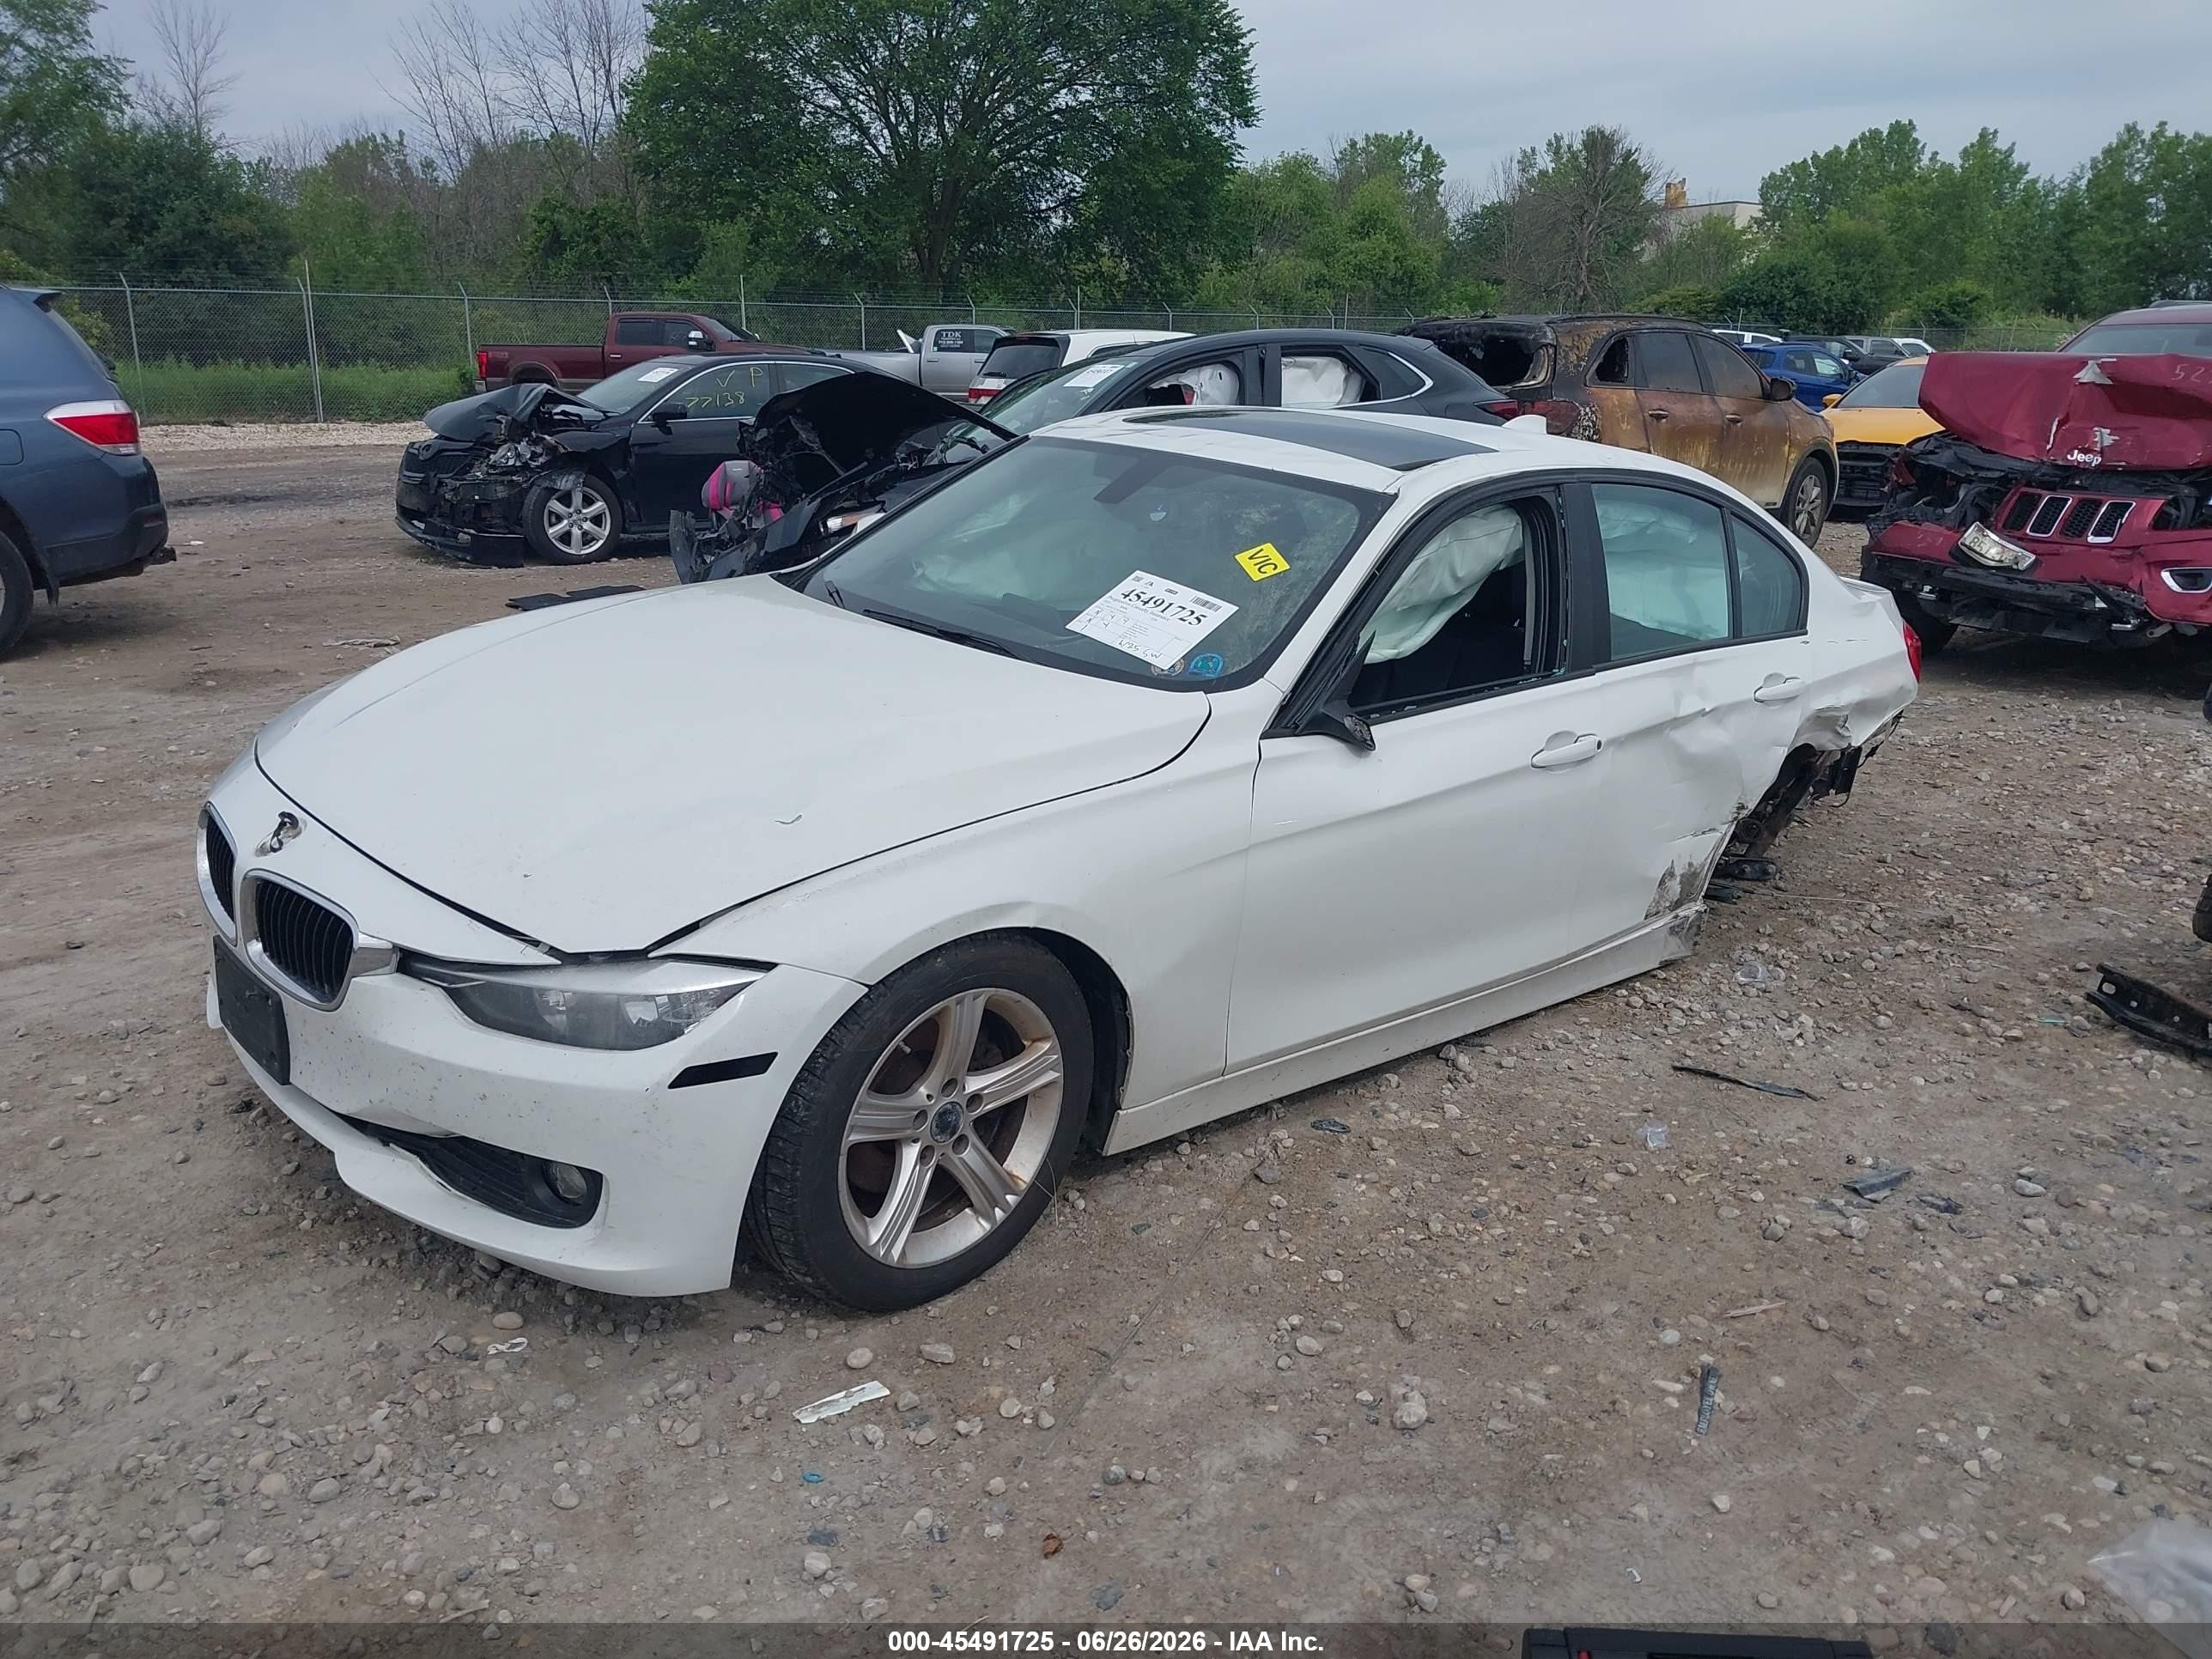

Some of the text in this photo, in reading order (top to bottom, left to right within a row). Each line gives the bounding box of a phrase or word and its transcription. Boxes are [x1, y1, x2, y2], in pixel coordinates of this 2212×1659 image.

[2066, 449, 2103, 467] Jeep
[1248, 548, 1278, 574] VIC
[1121, 588, 1209, 626] 45491725
